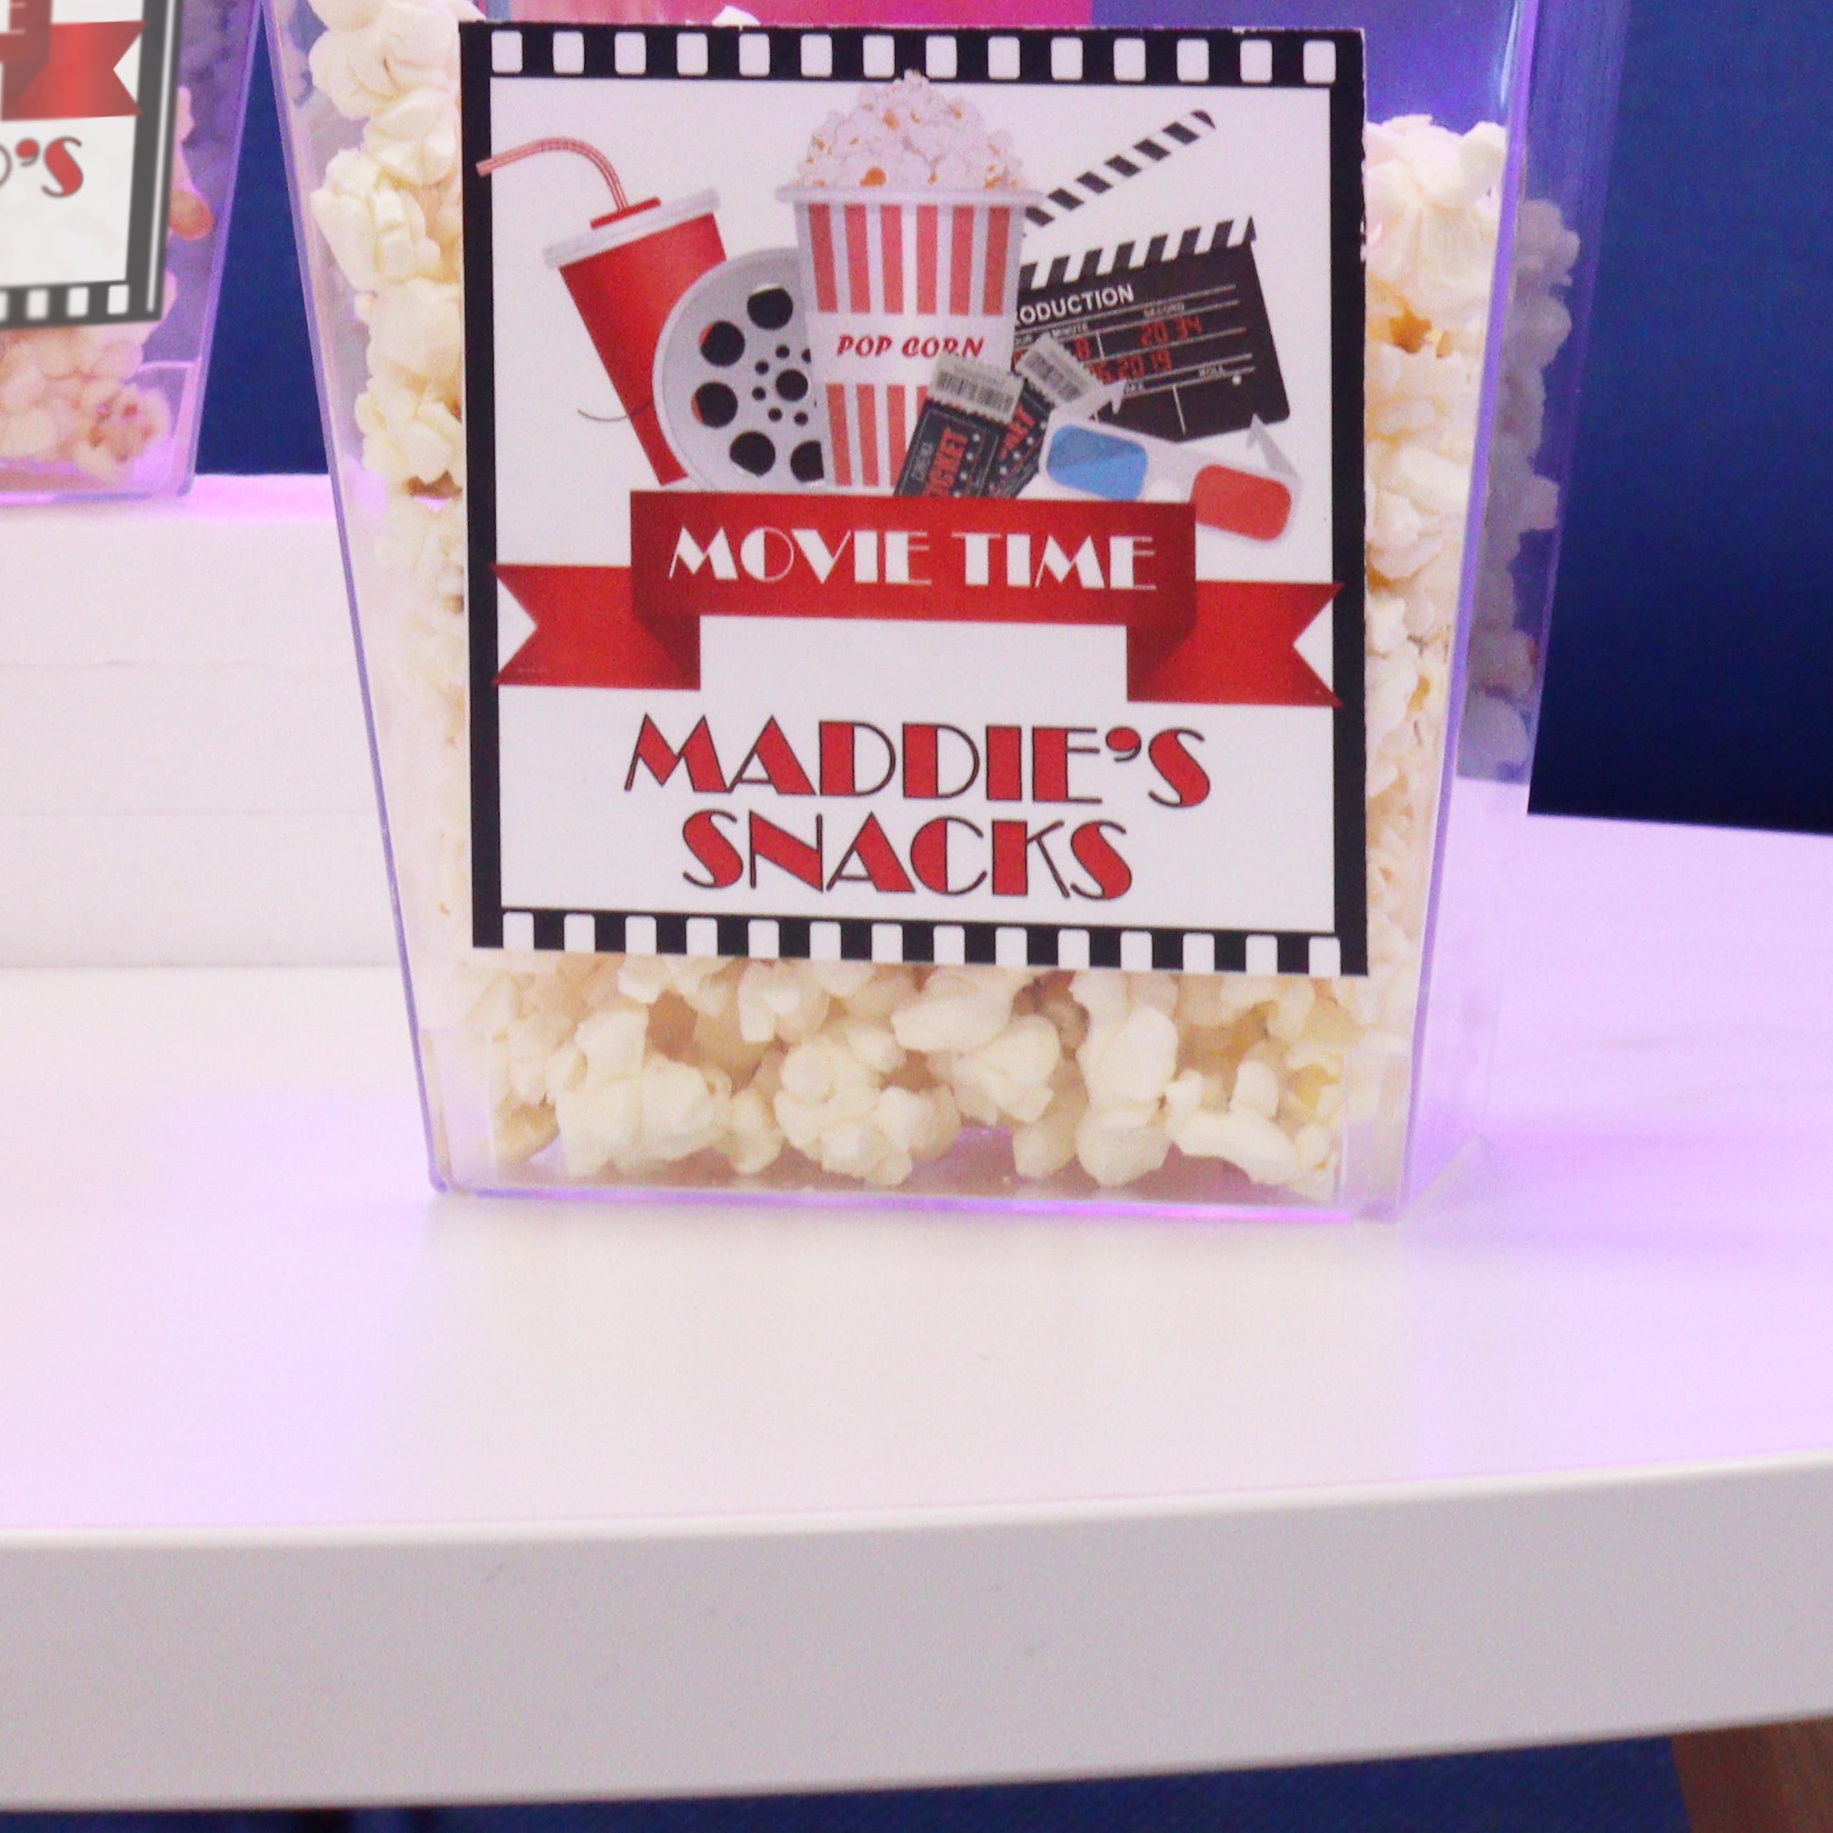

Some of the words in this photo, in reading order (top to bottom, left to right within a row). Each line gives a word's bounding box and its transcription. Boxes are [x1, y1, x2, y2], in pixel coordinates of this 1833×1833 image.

[836, 334, 893, 358] POP
[901, 335, 985, 359] CORN
[924, 427, 968, 496] ICKET
[669, 526, 932, 585] MOVIE
[952, 532, 1156, 590] TIME
[624, 713, 1211, 808] MADDIE'S
[682, 809, 1133, 901] SNACKS
